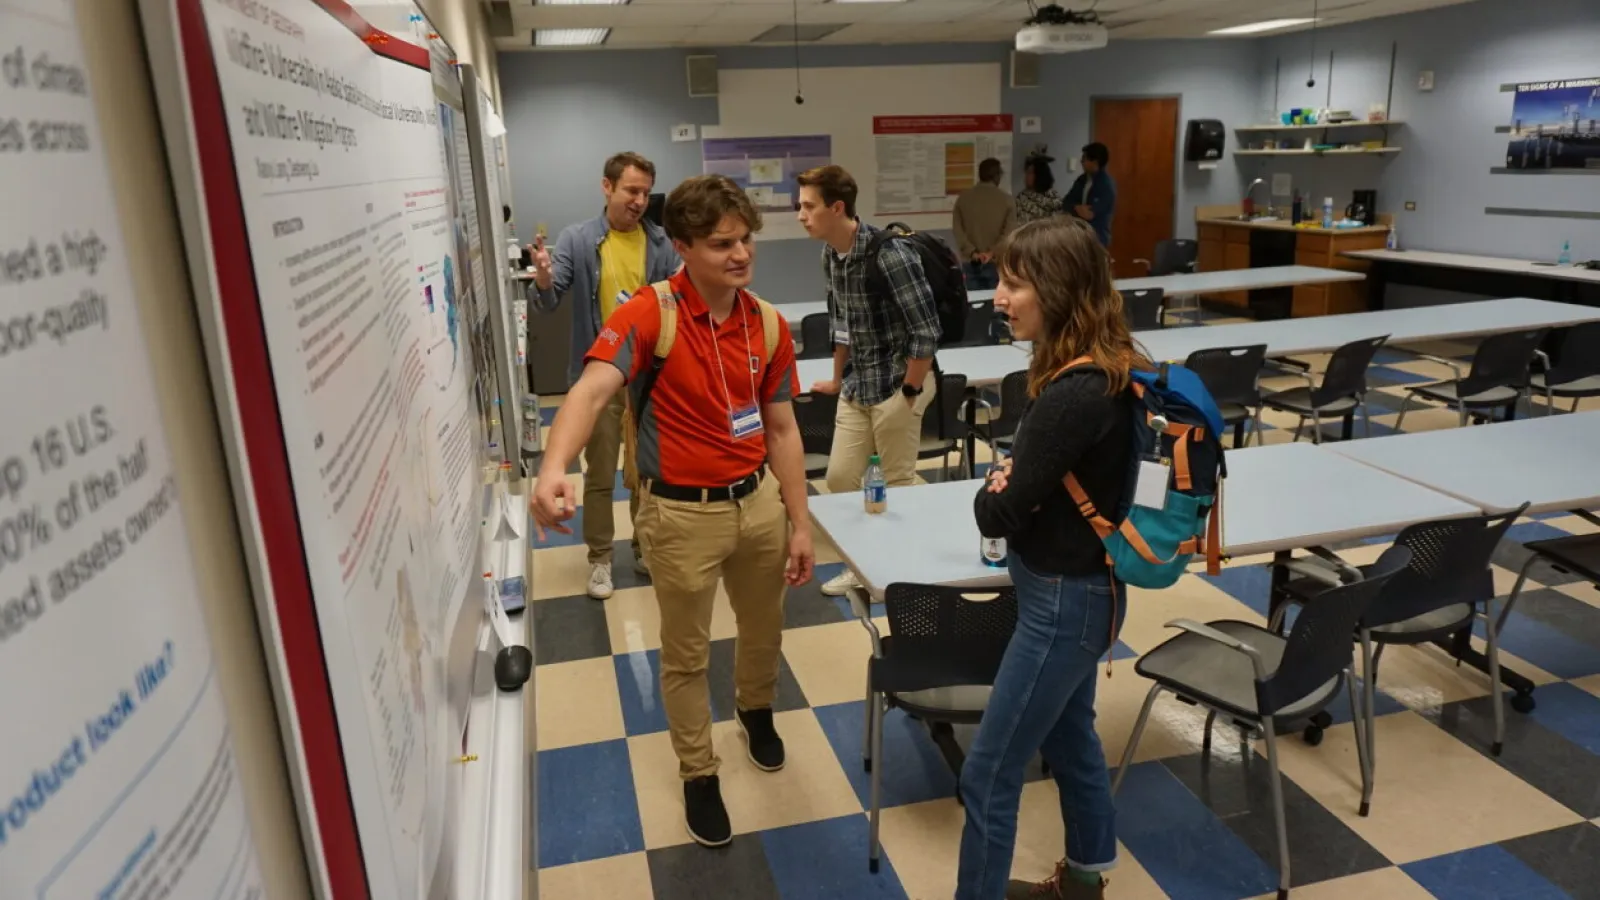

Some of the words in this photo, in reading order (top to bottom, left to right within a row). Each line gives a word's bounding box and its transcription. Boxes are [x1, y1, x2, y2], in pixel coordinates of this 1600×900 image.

[1548, 80, 1559, 90] OF
[1559, 80, 1564, 89] A
[46, 243, 64, 276] a
[31, 425, 68, 475] 16
[55, 480, 84, 531] of
[82, 470, 120, 513] the
[48, 528, 126, 604] assets
[85, 689, 137, 752] look
